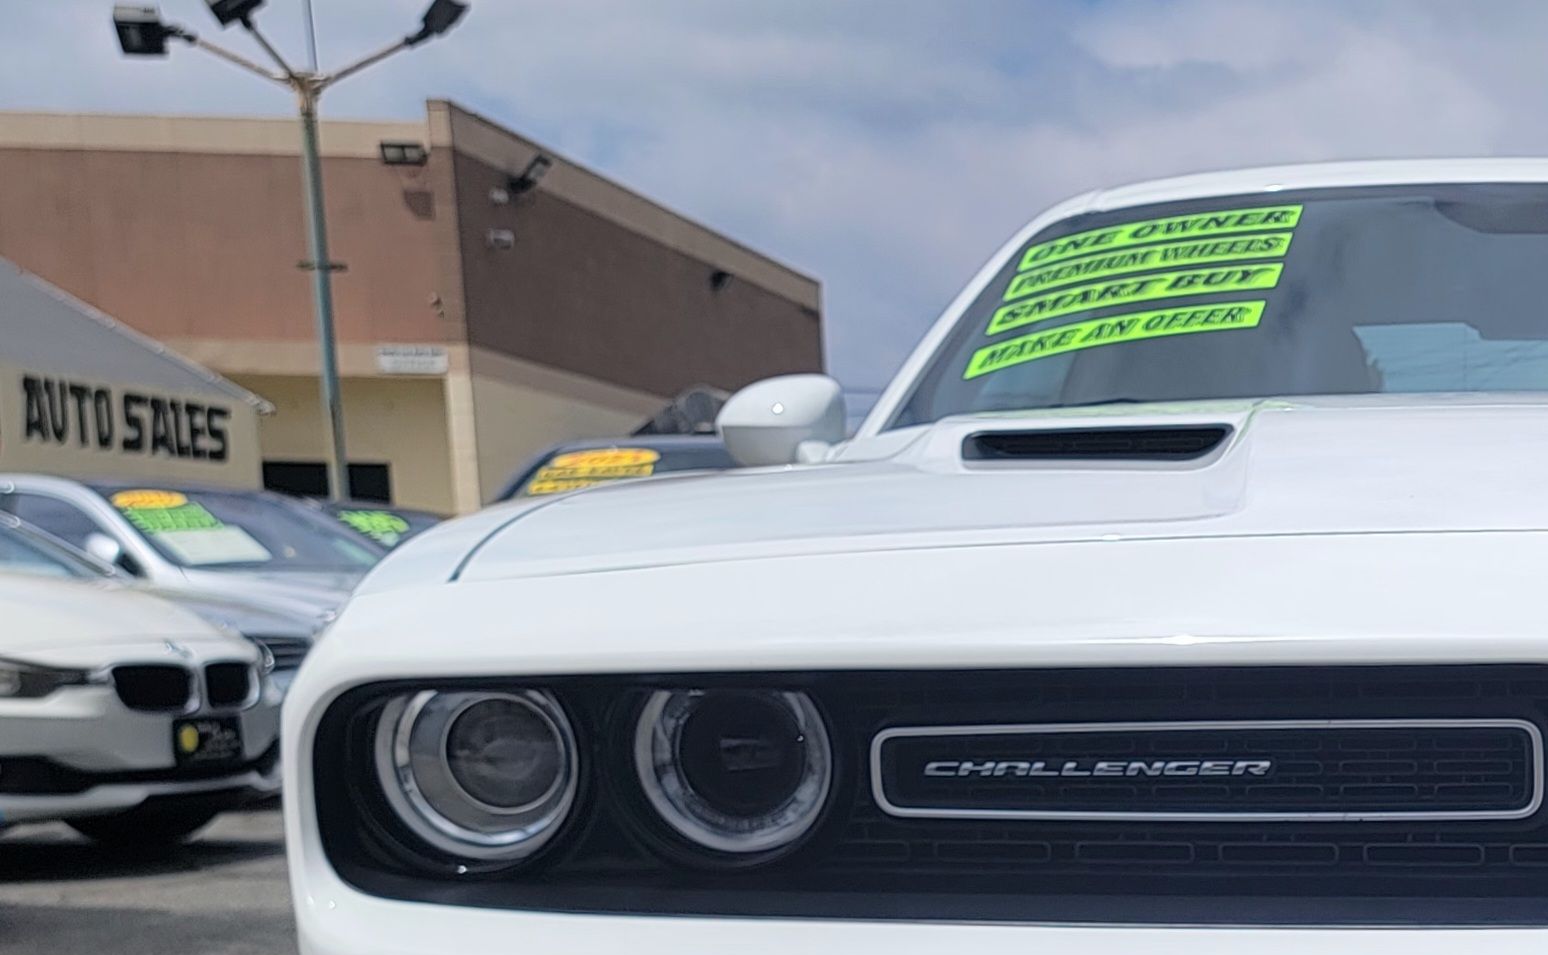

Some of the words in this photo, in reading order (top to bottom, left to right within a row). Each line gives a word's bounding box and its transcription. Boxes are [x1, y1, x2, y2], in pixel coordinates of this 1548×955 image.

[1030, 229, 1121, 261] ONE
[1130, 209, 1297, 239] OWNER
[1011, 250, 1157, 294] PREMIUM
[1158, 236, 1286, 261] WHEELS
[996, 277, 1160, 325] SMART
[1164, 267, 1275, 291] BUY
[977, 327, 1080, 369] MAKE
[1081, 317, 1136, 343] AN
[1142, 306, 1252, 331] OFFER
[22, 374, 114, 447] AUTO
[122, 393, 231, 462] SALES
[923, 760, 1272, 777] CHALLENGER
